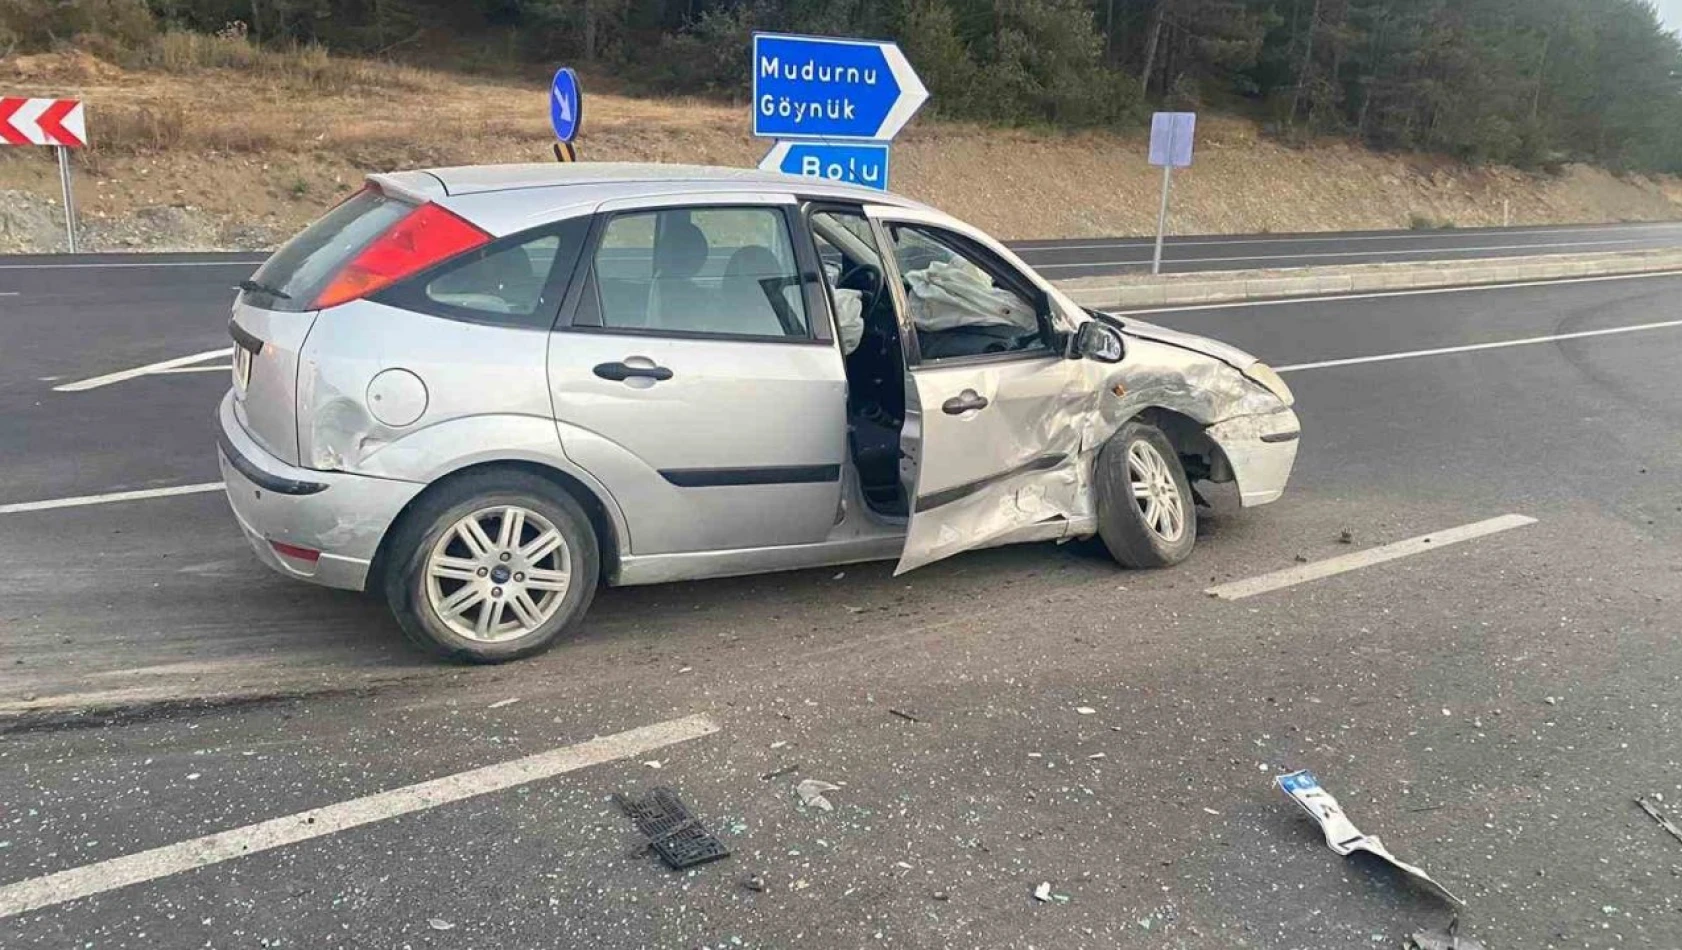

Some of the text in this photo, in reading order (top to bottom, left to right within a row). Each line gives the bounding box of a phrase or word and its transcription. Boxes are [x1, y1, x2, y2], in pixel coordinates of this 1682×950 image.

[760, 56, 877, 85] Mudurnu
[760, 94, 855, 123] Göynük
[802, 156, 879, 182] Bolu
